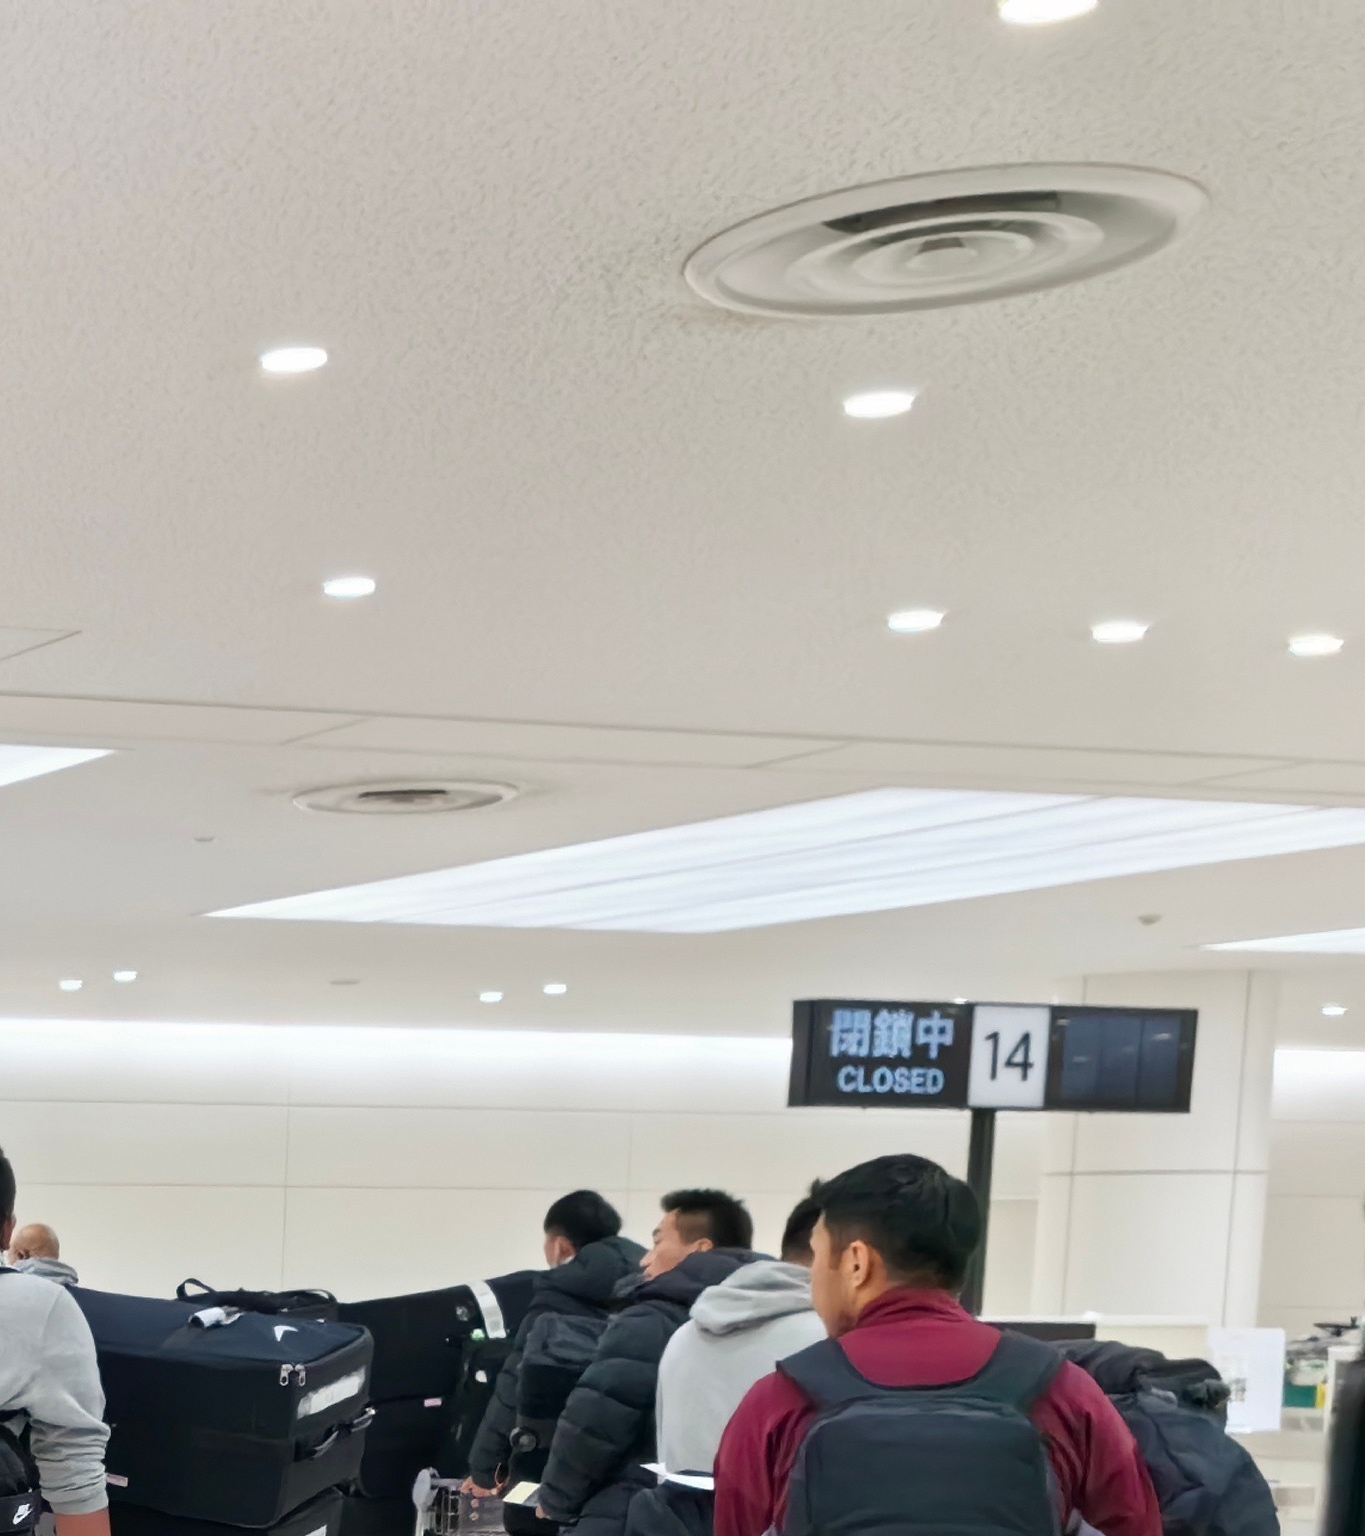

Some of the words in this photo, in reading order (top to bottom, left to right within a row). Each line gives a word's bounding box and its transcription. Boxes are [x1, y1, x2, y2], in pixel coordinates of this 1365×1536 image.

[829, 1008, 955, 1060] 閉鎖中
[984, 1031, 1034, 1082] 14
[837, 1065, 945, 1095] CLOSED
